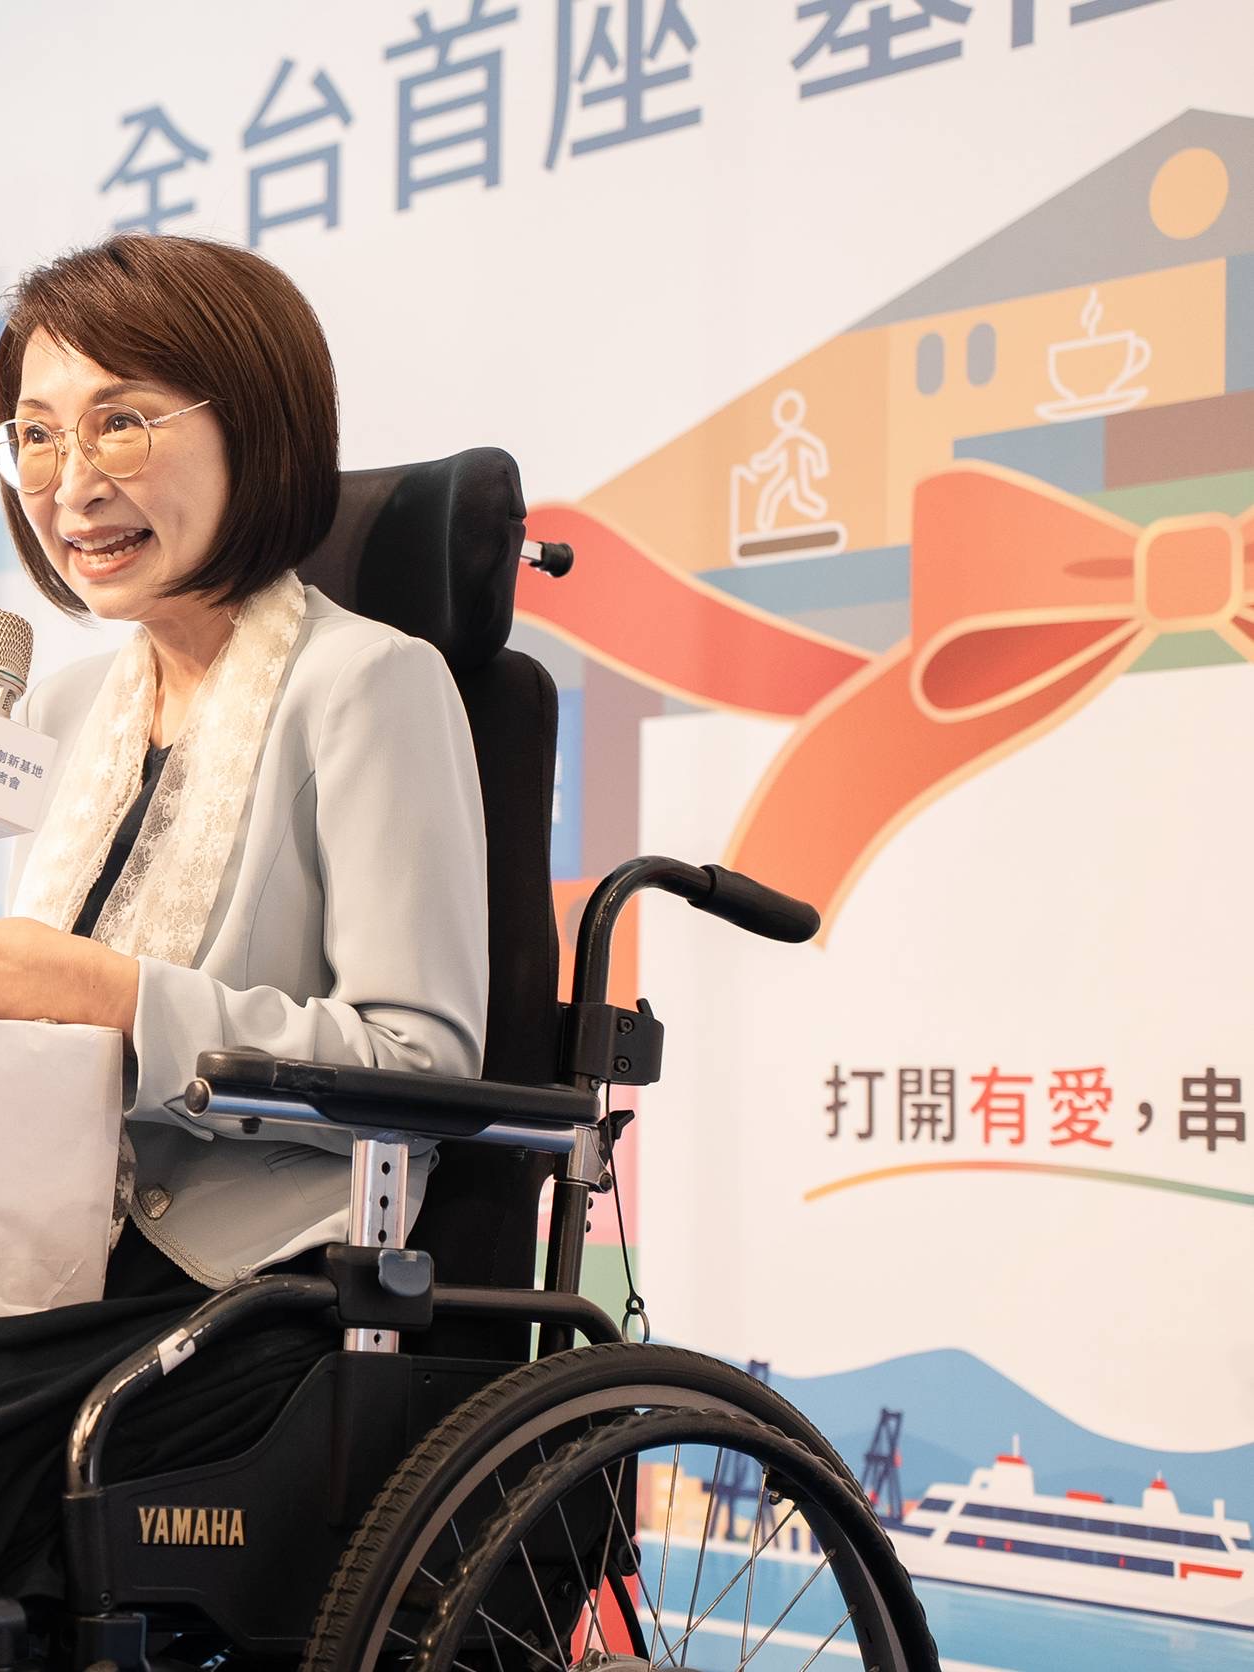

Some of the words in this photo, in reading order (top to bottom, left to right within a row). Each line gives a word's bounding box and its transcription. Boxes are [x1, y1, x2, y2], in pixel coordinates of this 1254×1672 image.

[99, 0, 702, 249] 全台首座
[137, 1506, 245, 1546] YAMAHA
